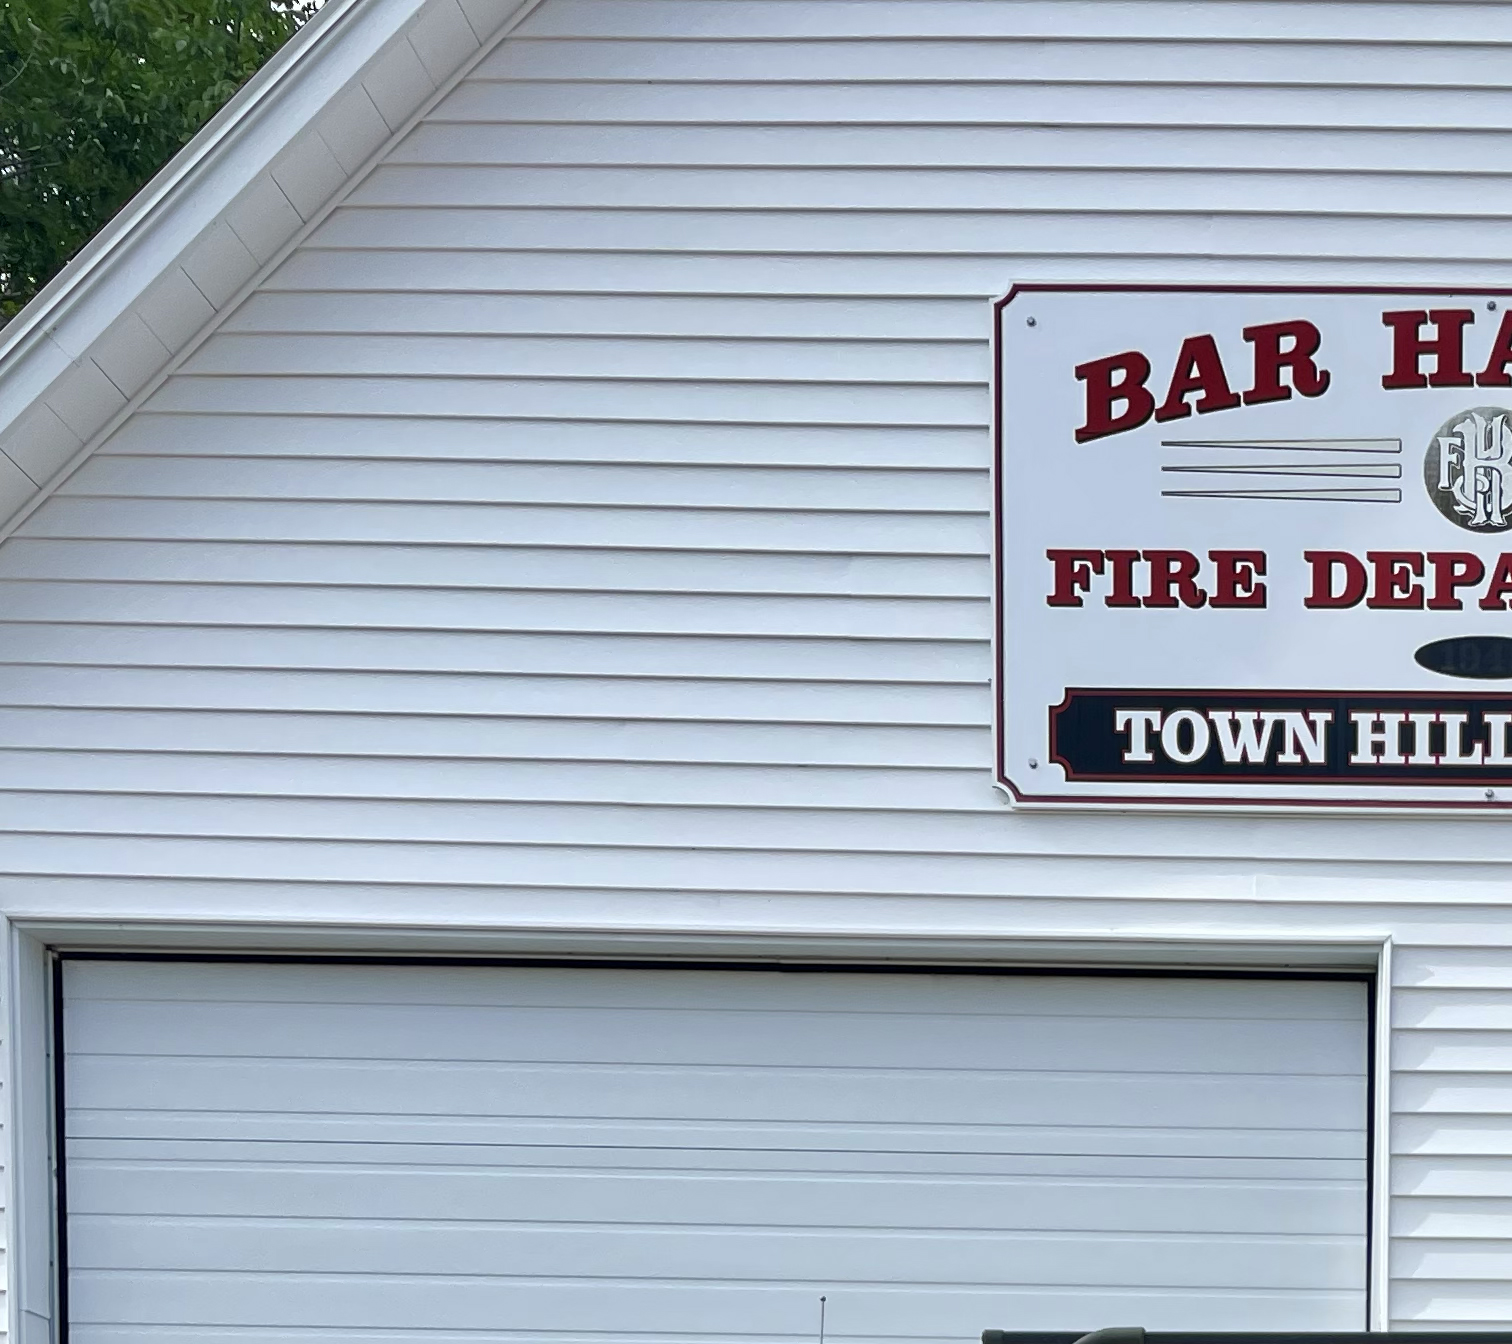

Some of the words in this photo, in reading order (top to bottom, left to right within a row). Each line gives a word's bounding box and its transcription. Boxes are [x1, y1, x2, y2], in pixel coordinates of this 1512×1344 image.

[1075, 319, 1330, 443] BAR
[1045, 548, 1267, 609] FIRE
[1114, 709, 1333, 764] TOWN
